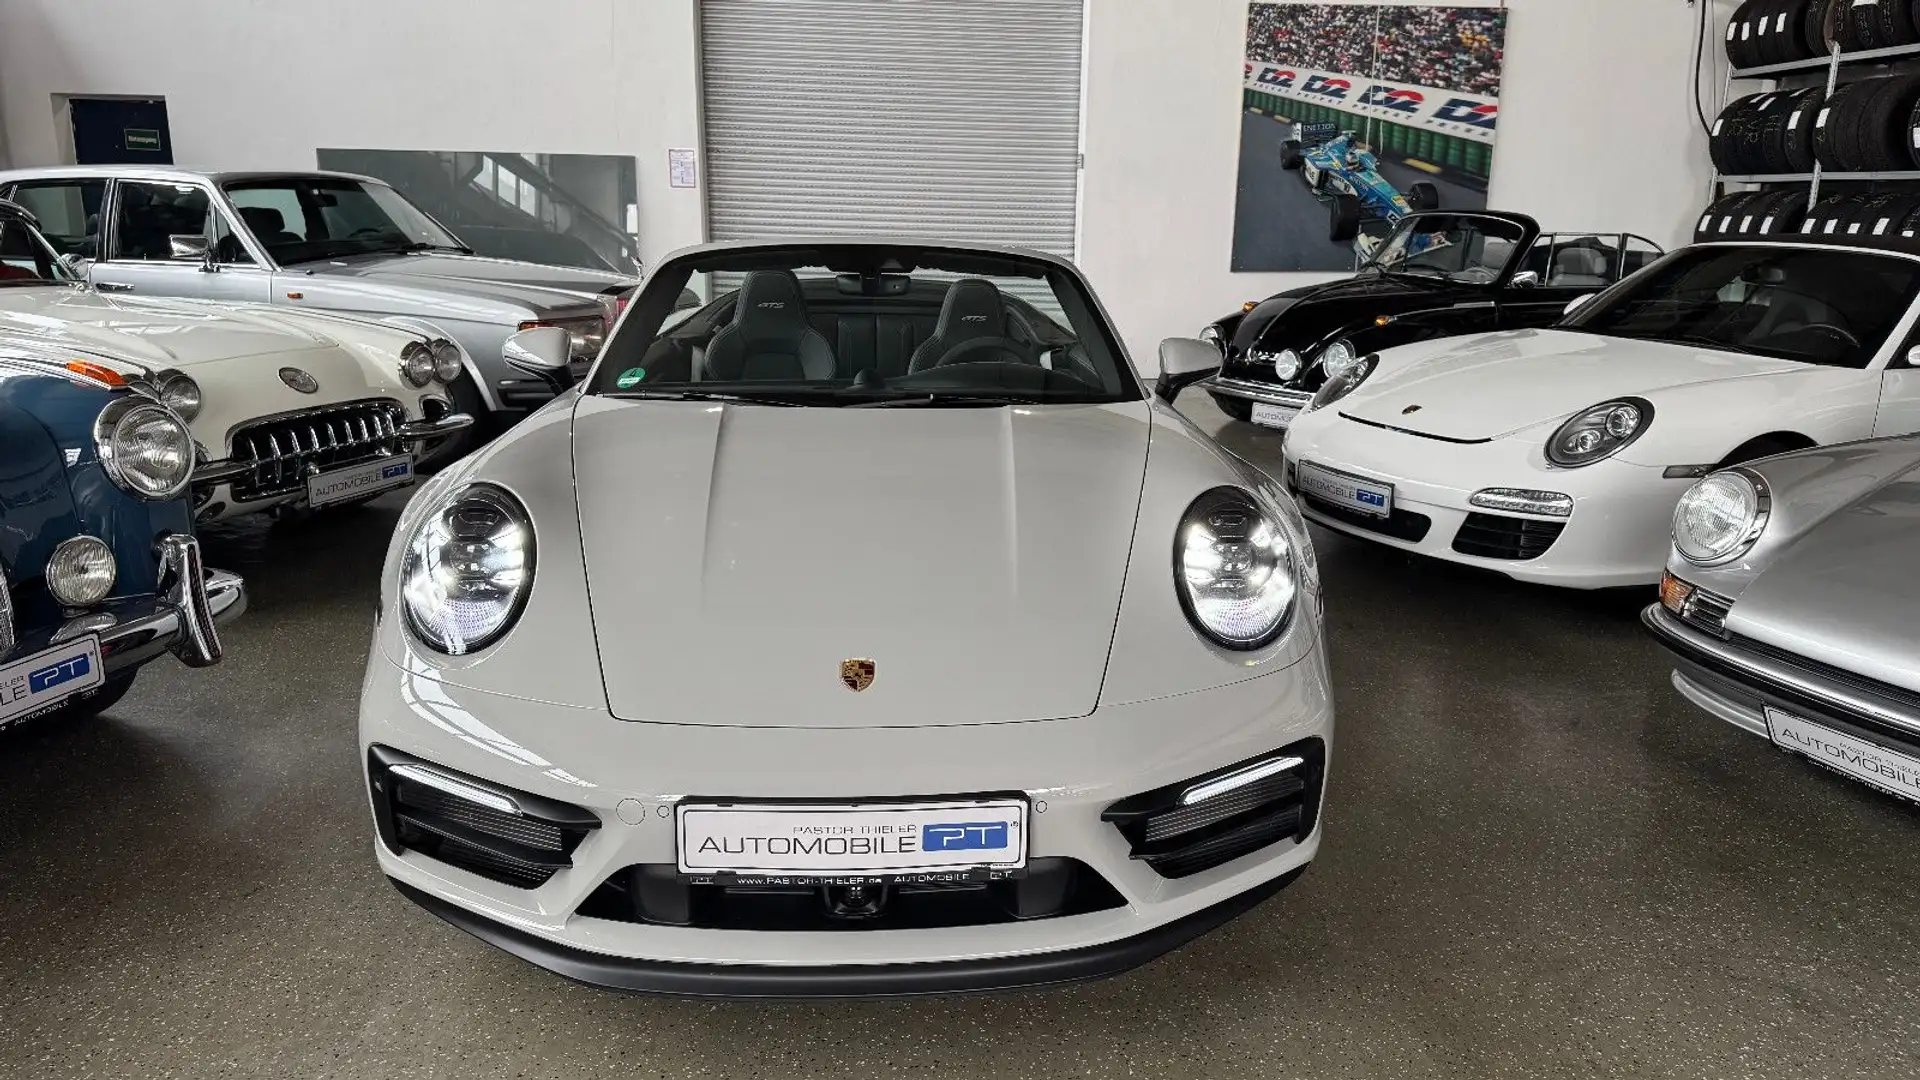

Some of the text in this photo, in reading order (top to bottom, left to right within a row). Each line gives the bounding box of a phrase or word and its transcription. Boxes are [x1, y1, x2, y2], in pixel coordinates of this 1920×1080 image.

[1300, 75, 1351, 98] D2
[1357, 86, 1424, 112] D2
[315, 472, 380, 497] AUTOMOBILE
[33, 657, 84, 687] PT
[698, 825, 1002, 855] AUTOMOBILE PT
[793, 824, 917, 835] PASTOR THIELER
[894, 873, 970, 883] AUTOMOBILE
